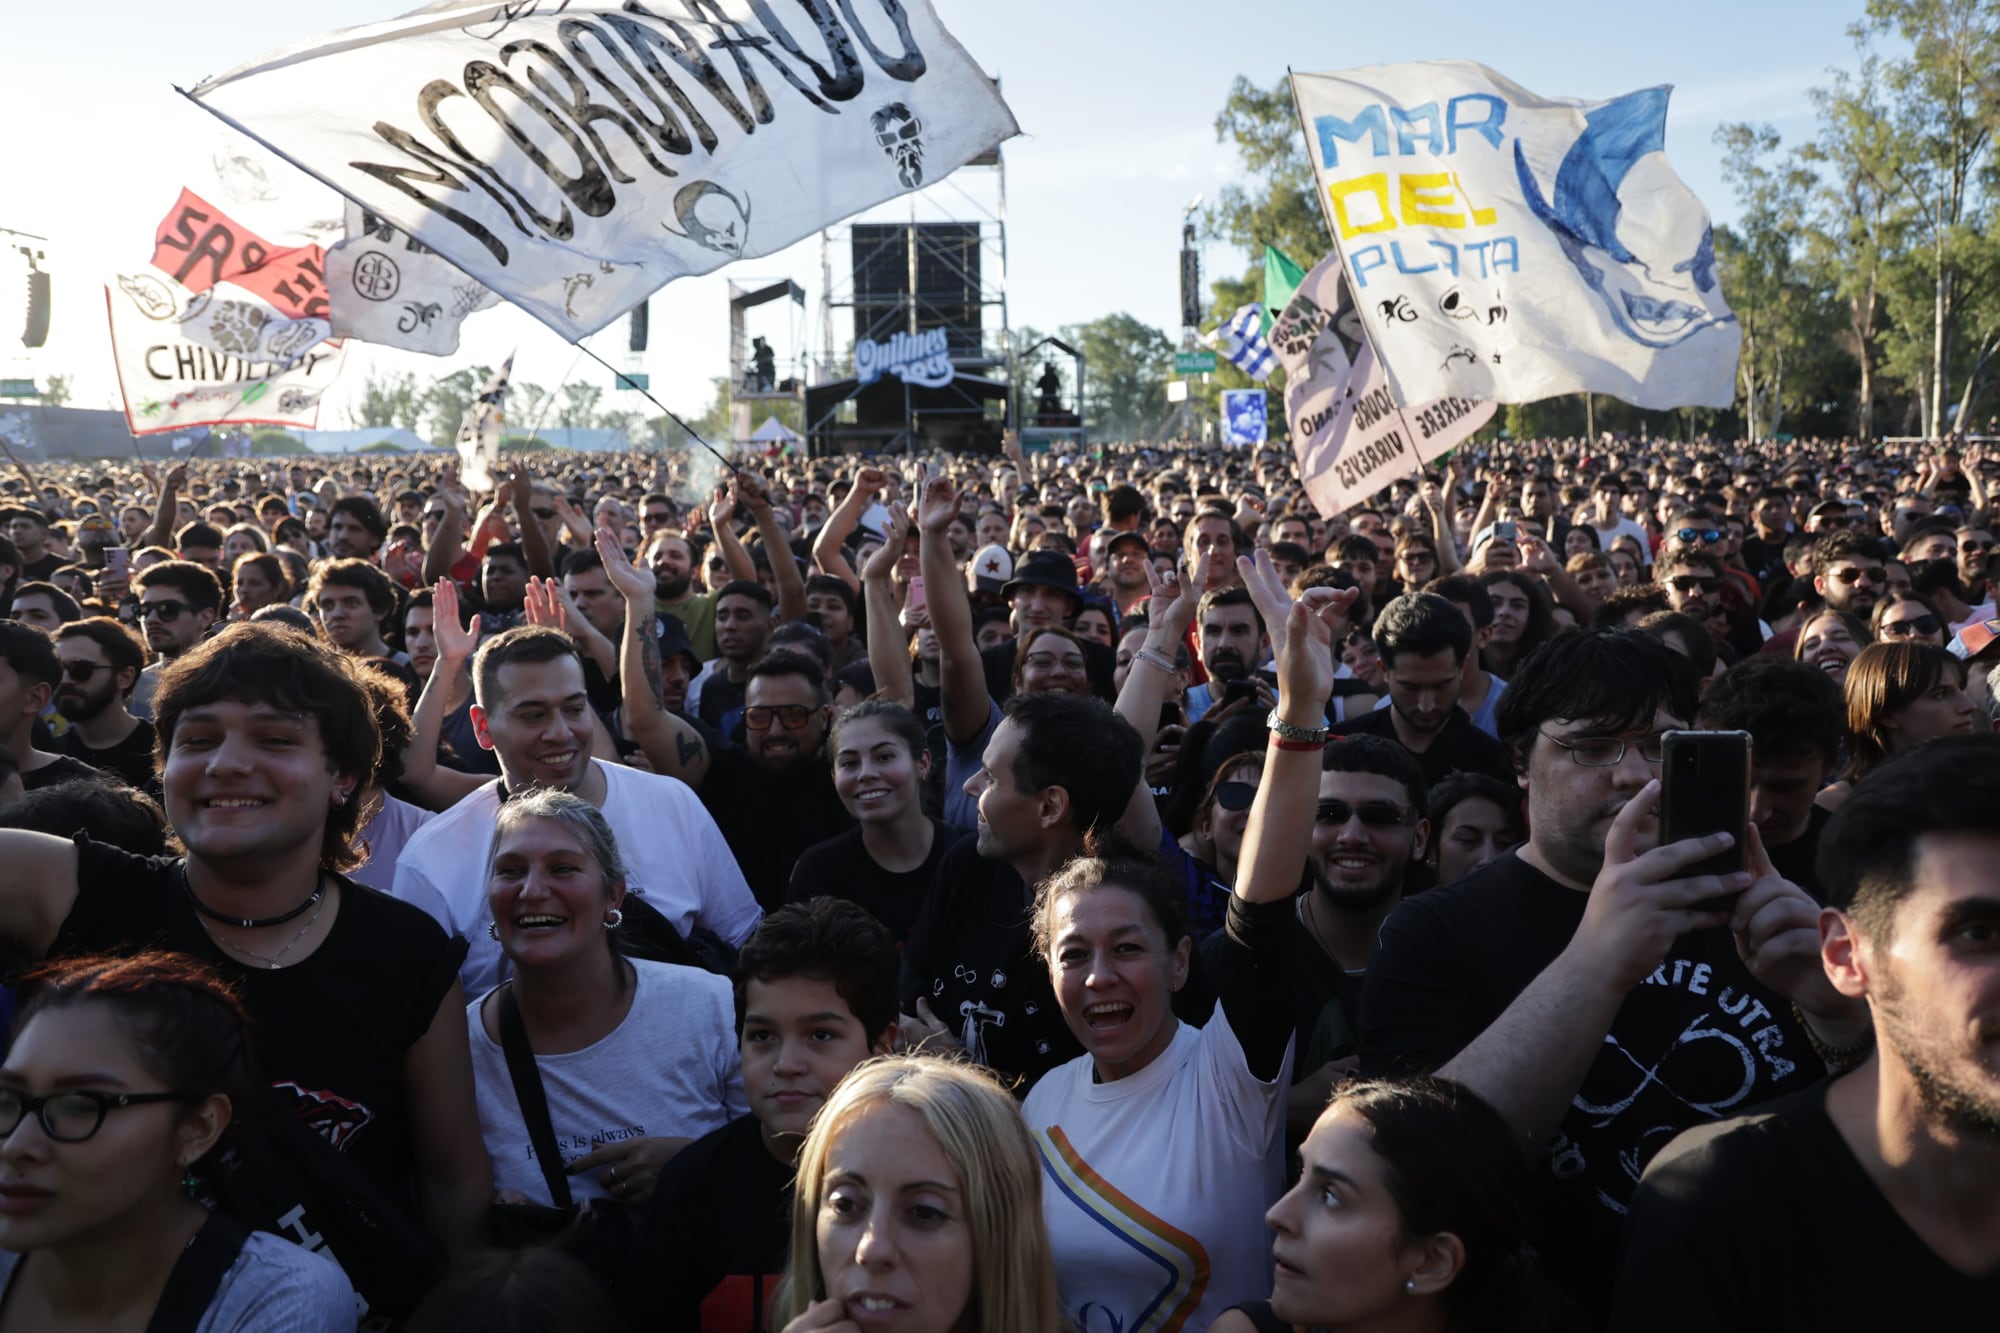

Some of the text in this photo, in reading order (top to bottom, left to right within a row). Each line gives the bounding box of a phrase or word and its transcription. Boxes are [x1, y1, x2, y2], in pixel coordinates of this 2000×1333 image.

[1314, 93, 1508, 169] MAR
[1329, 171, 1497, 240] DEL
[1349, 235, 1519, 288] PLATA
[855, 326, 948, 384] Quilmes
[572, 1135, 587, 1149] is
